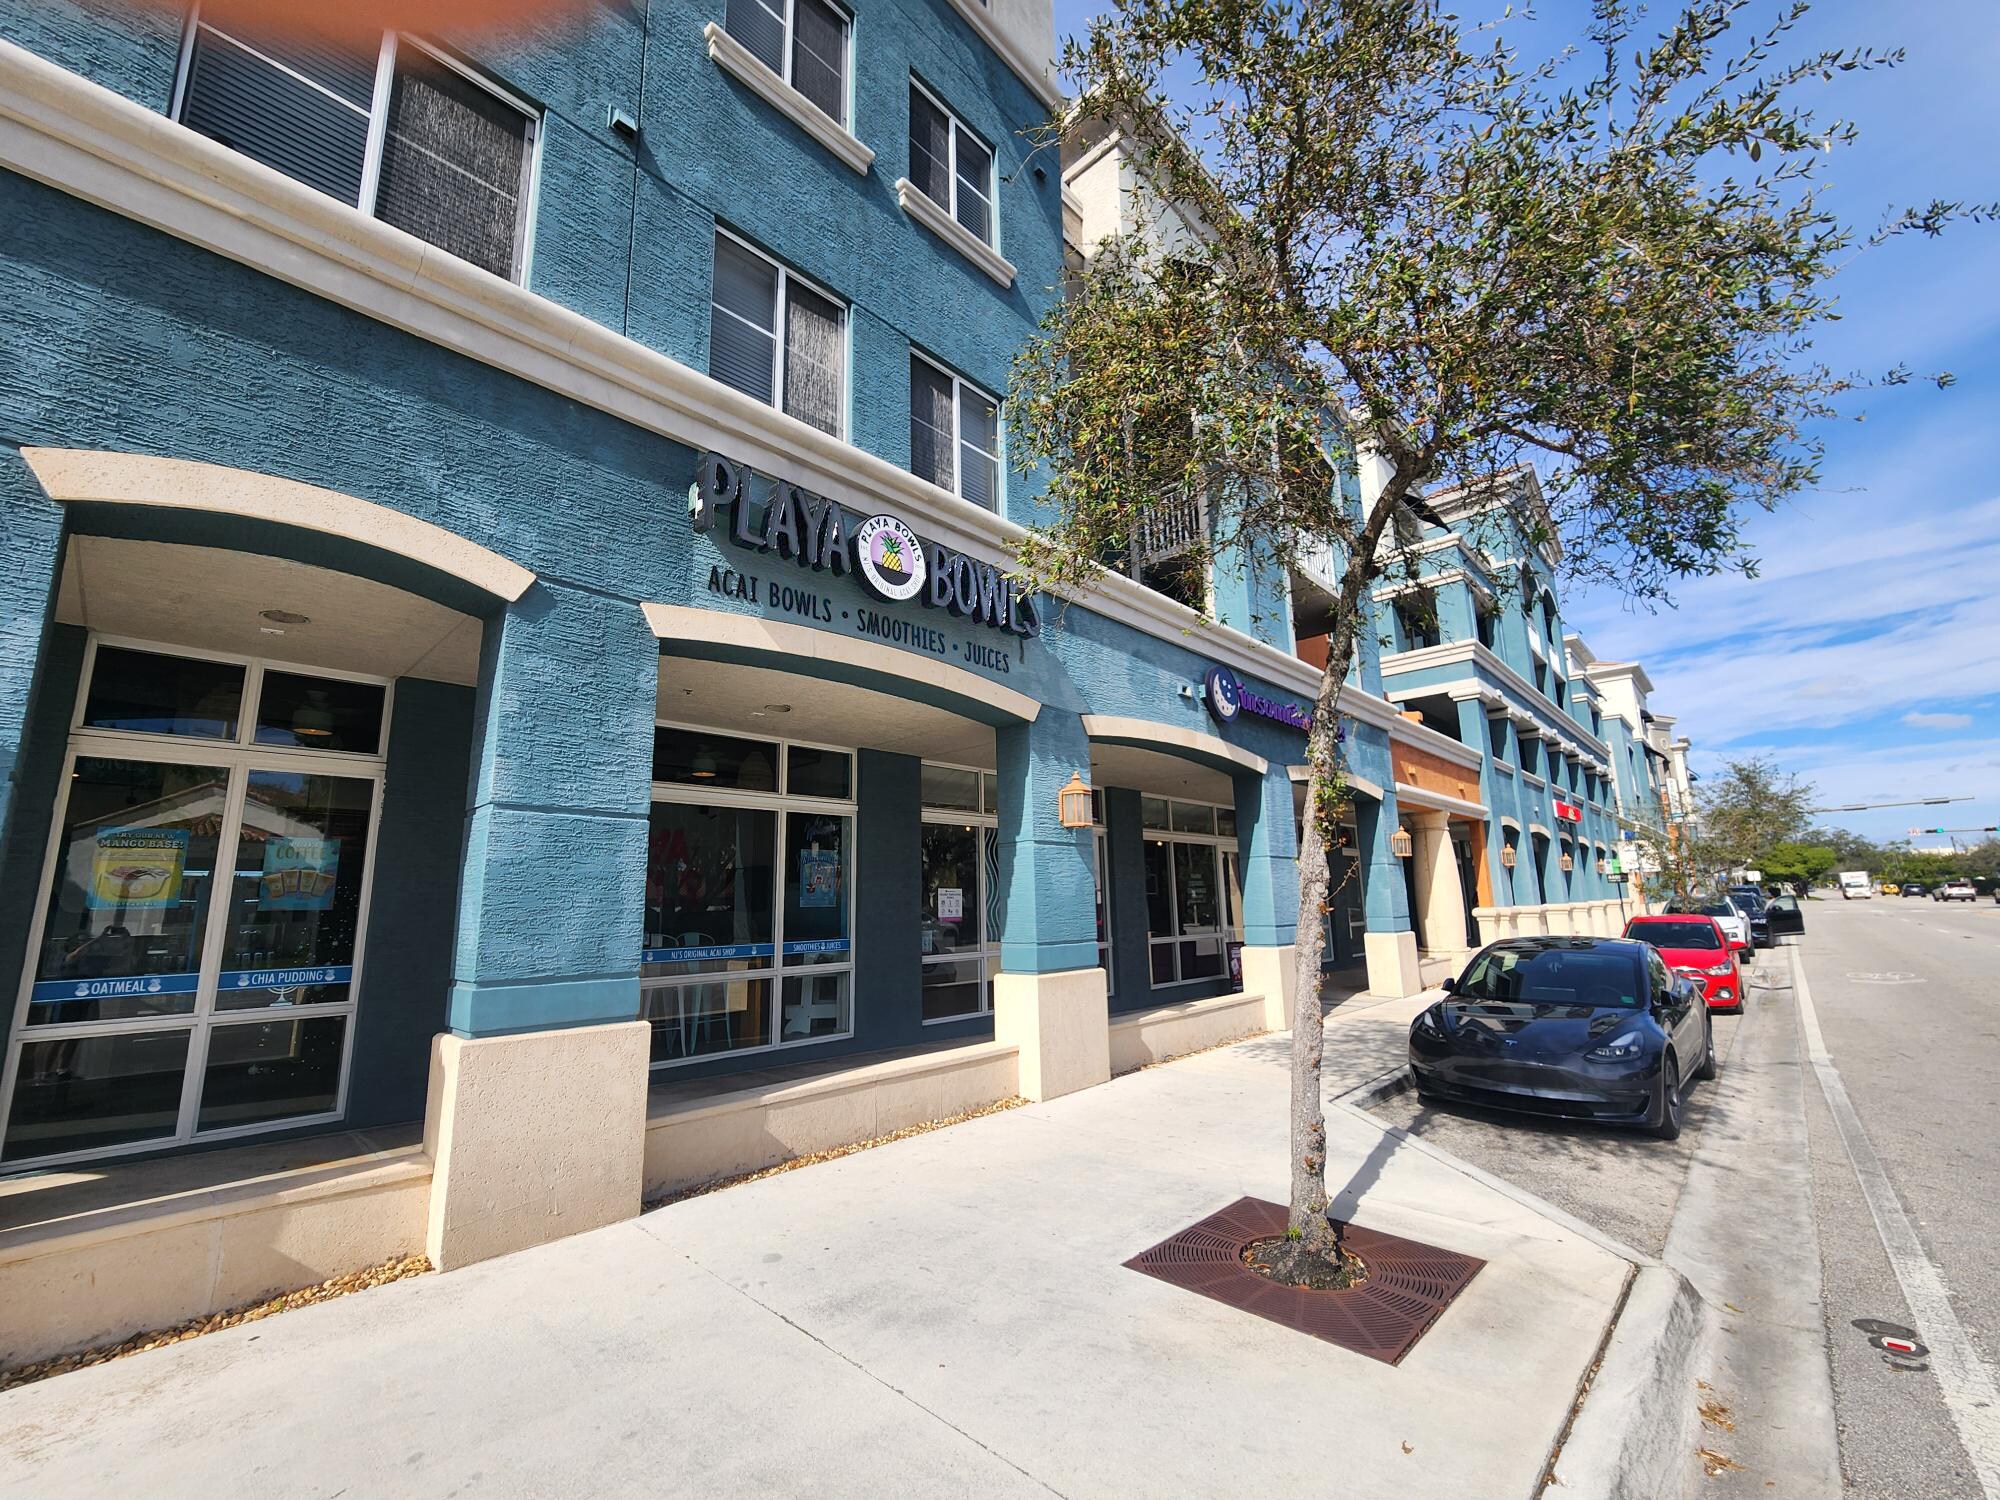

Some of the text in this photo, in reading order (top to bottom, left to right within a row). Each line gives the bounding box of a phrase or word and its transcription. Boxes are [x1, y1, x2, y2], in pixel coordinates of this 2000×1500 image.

[698, 451, 852, 575] PLAYA
[861, 517, 922, 562] PLAYA BOWLS
[871, 574, 898, 597] ORIGINAL
[707, 565, 1010, 674] ACAI BOWLS SMOOTHIES JUICES
[99, 838, 184, 849] MANGO BASE!
[671, 947, 737, 959] NJ'S ORIGINAL ACAI SHOP
[793, 941, 841, 952] SMOOTHIES JUICES
[251, 970, 324, 985] CHIA PUDDING
[91, 980, 147, 995] OATMEAL
